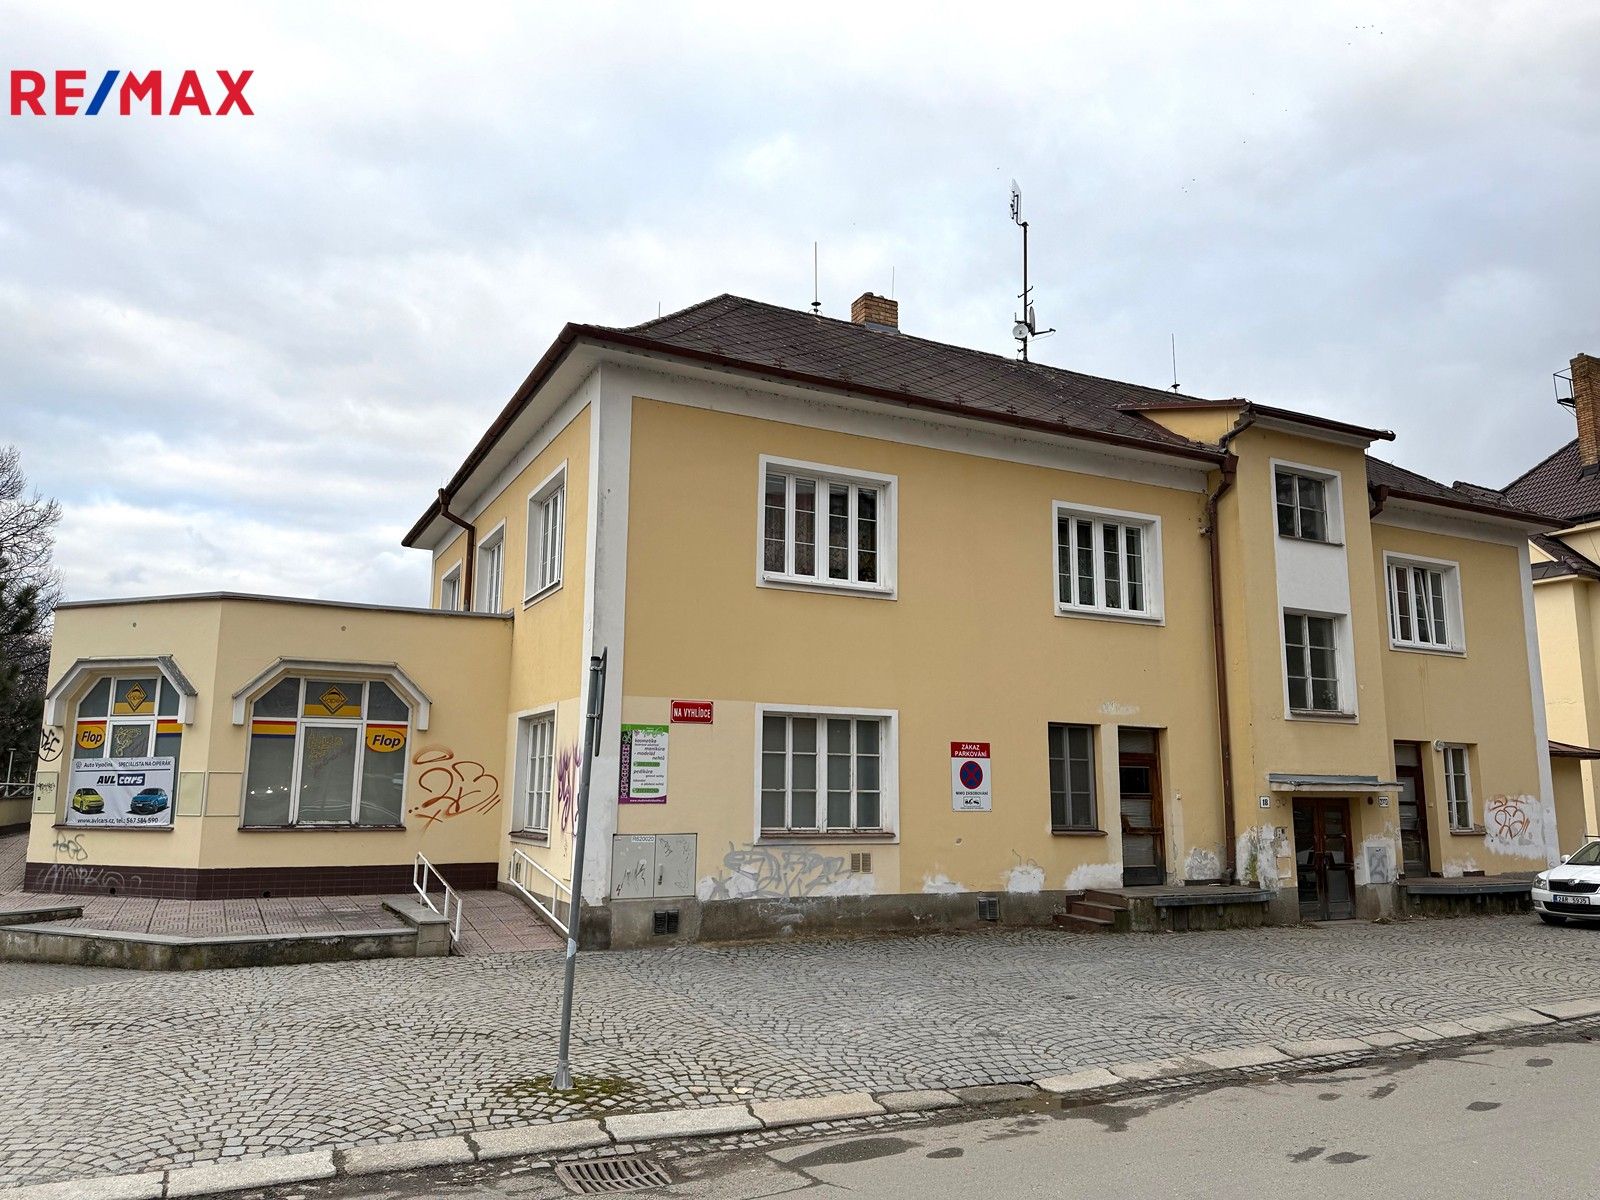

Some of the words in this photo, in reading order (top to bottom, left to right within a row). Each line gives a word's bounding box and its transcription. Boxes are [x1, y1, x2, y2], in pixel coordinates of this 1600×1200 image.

[674, 707, 682, 717] NA
[684, 706, 711, 719] VYHLÍDCE
[81, 731, 102, 744] Flop
[372, 734, 401, 748] Flop
[97, 775, 116, 784] AVL
[119, 775, 143, 784] cars
[1262, 798, 1269, 806] 18
